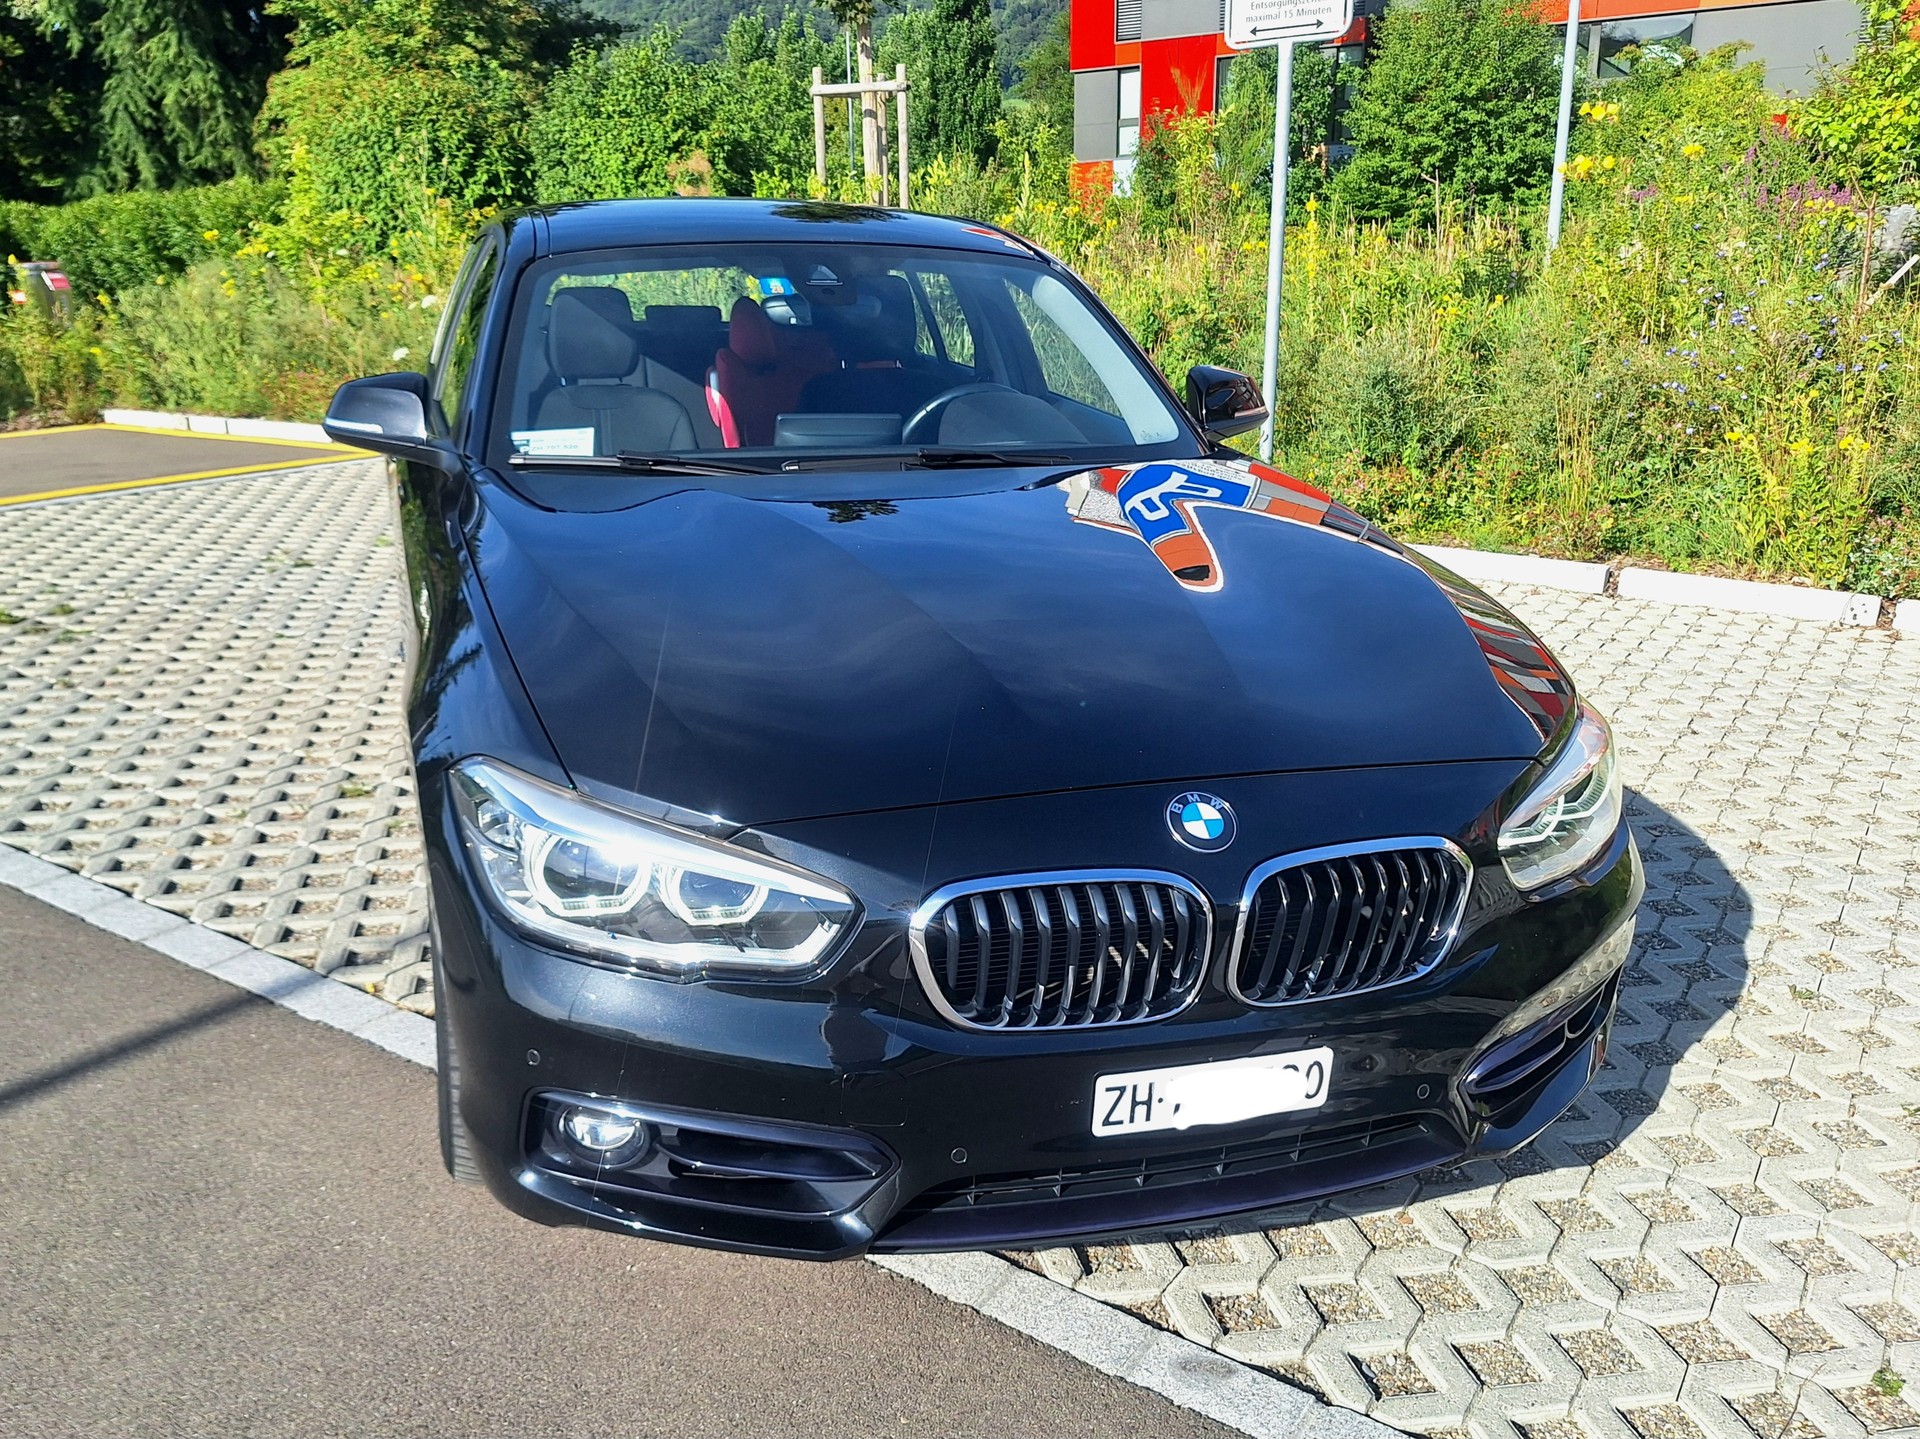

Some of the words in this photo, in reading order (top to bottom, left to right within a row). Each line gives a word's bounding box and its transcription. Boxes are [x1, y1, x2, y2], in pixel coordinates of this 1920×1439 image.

[1246, 11, 1281, 23] maximal
[1284, 9, 1294, 19] 15
[1296, 6, 1332, 17] Minuten
[1171, 793, 1223, 814] BMW
